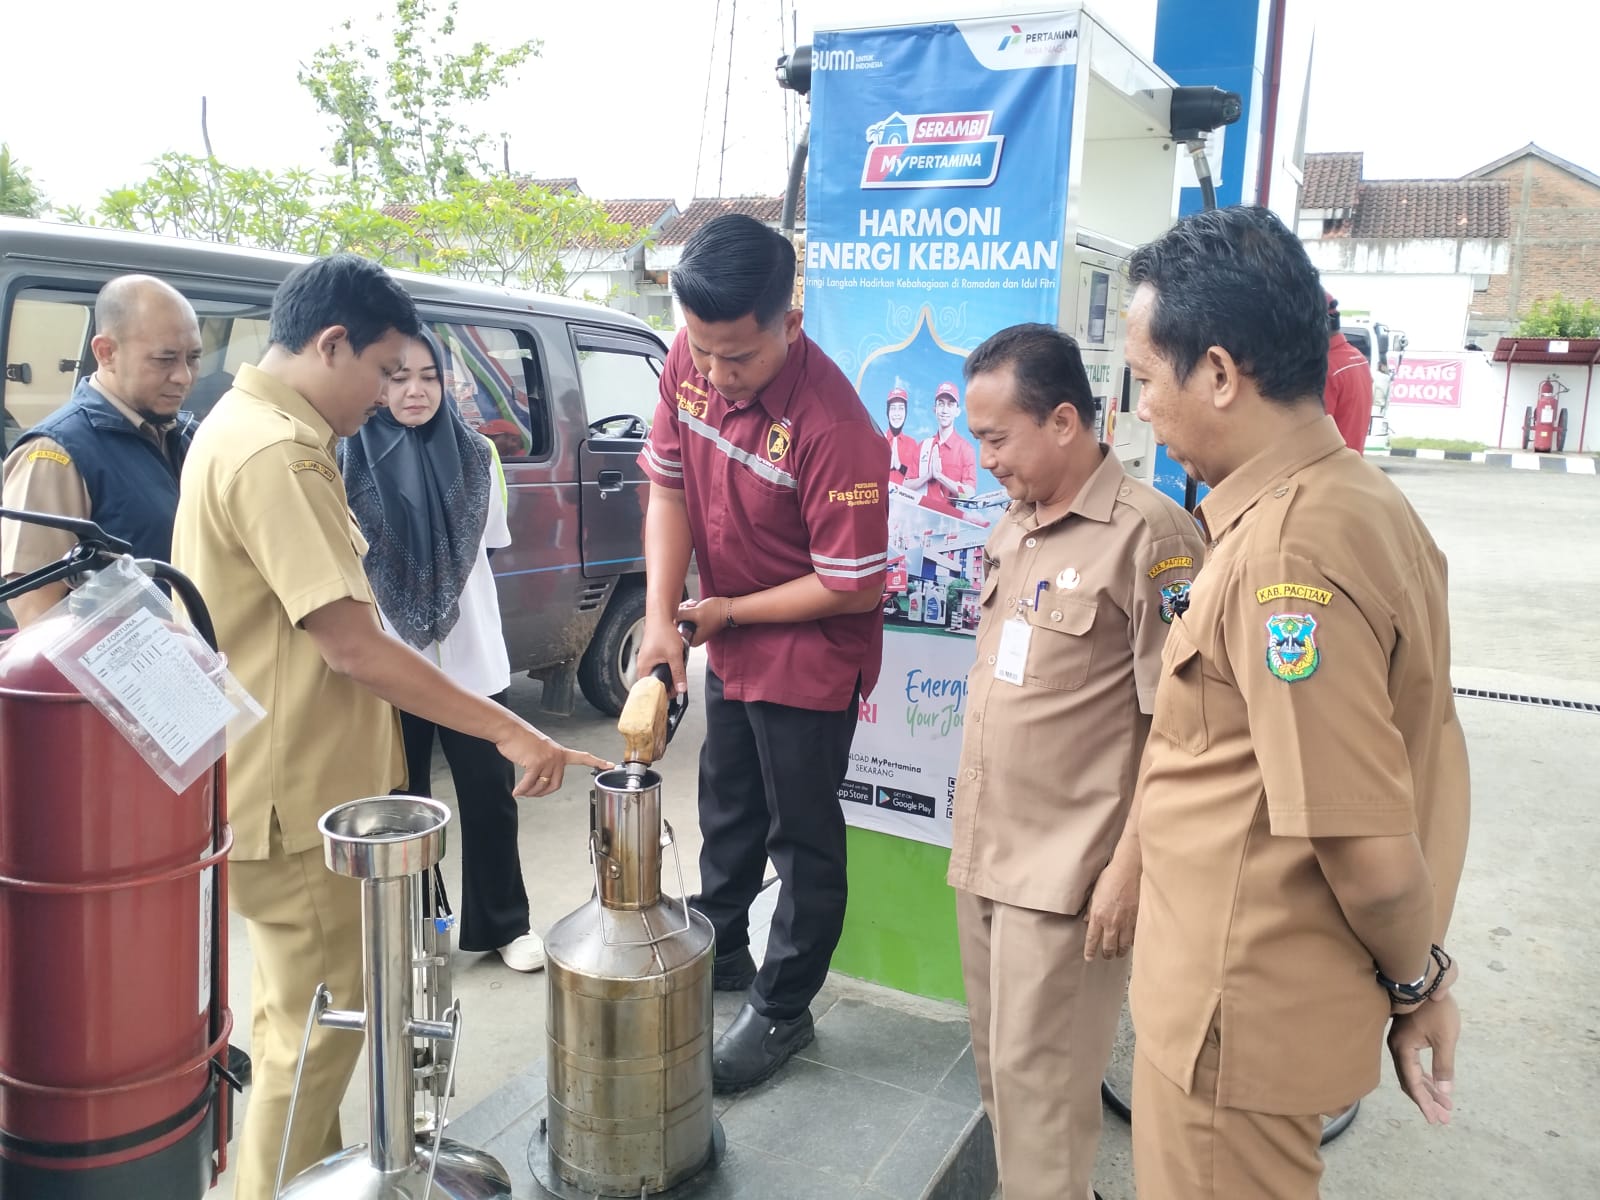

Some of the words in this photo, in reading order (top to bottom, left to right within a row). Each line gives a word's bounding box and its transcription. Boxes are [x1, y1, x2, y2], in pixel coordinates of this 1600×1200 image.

[1025, 29, 1078, 43] PERTAMINA
[856, 62, 884, 70] INDONESIA
[916, 119, 985, 138] SERAMBI
[880, 153, 982, 177] MyPERTAMINA
[859, 207, 1001, 237] HARMONI
[807, 243, 901, 270] ENERGI
[908, 241, 1058, 271] KEBAIKAN
[827, 277, 858, 289] Langkah
[860, 277, 895, 288] Hadirkan
[897, 277, 949, 291] Kebahagiaan
[951, 277, 959, 288] di
[962, 277, 1000, 289] Ramadan
[1002, 277, 1019, 289] dan
[1021, 277, 1037, 289] Idul
[1040, 277, 1056, 288] Fitri
[828, 489, 880, 503] Fastron
[1259, 586, 1282, 601] KAB.
[1284, 585, 1329, 603] PACITAN
[107, 619, 137, 644] FORTUNA
[905, 668, 968, 713] Energi
[858, 701, 878, 724] RI
[906, 704, 940, 738] Your
[855, 764, 895, 777] SEKARANG
[871, 757, 922, 773] MyPertamina
[836, 789, 849, 798] pp
[849, 789, 869, 801] Store
[892, 797, 918, 811] Google
[918, 803, 932, 815] Play
